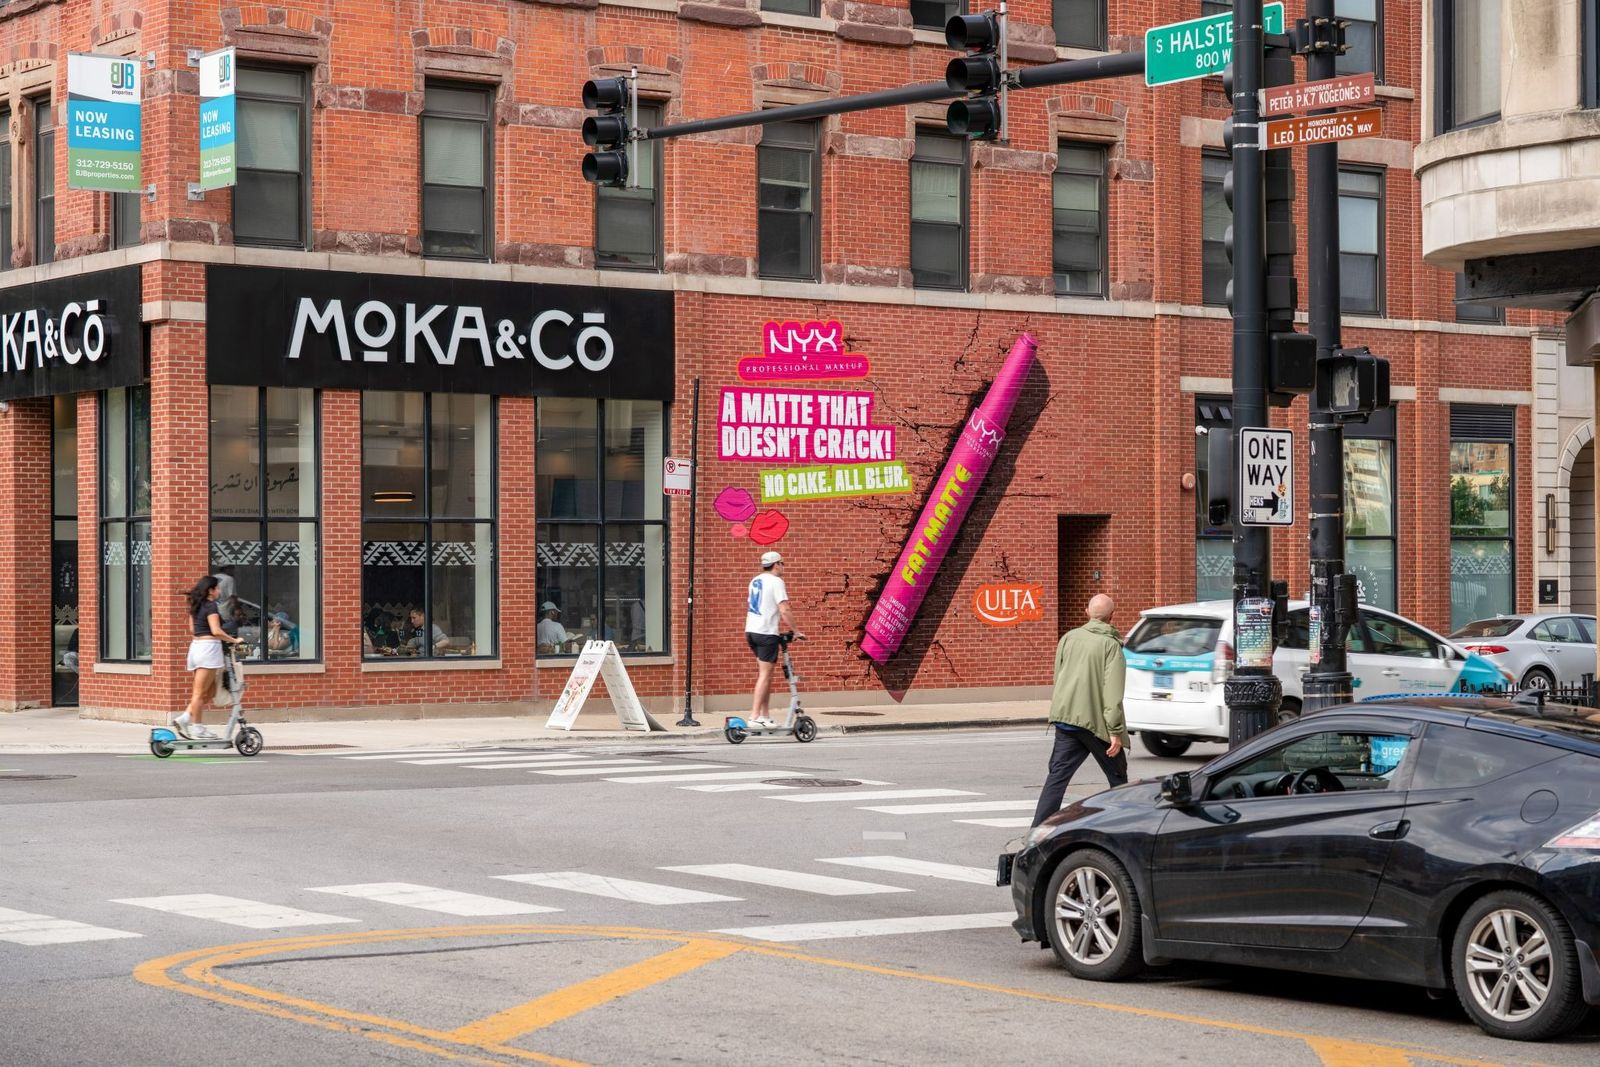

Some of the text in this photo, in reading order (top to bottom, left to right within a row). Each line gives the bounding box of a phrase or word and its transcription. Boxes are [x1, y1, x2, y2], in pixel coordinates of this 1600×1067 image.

[1156, 39, 1163, 53] S
[1170, 21, 1233, 54] HALSTE
[1196, 48, 1232, 69] 800 W
[1270, 86, 1371, 111] PETER P.K.7 KOGEONES ST
[1304, 83, 1333, 93] HONORARY
[75, 110, 108, 124] NOW
[202, 109, 219, 123] NOW
[1307, 118, 1338, 127] HONORARY
[75, 125, 135, 141] LEASING
[202, 121, 231, 139] LEASING
[1274, 123, 1373, 144] LEO LOUCHIOS WAY
[75, 169, 135, 181] BJBproperties.com
[76, 159, 134, 171] 312-729-5150
[769, 328, 838, 354] NYX
[745, 362, 863, 374] PROFESSIONAL MAKEUP
[721, 392, 870, 427] A MATTE THAT
[968, 412, 1003, 449] NYX
[721, 425, 892, 460] DOESN'T CRACK!
[1248, 437, 1287, 460] ONE
[764, 465, 909, 498] NO CAKE. ALL BLUR.
[1247, 464, 1288, 487] WAY
[901, 463, 972, 587] FAT MATTE
[889, 595, 907, 613] SMOOTH
[985, 589, 1036, 611] ULTA
